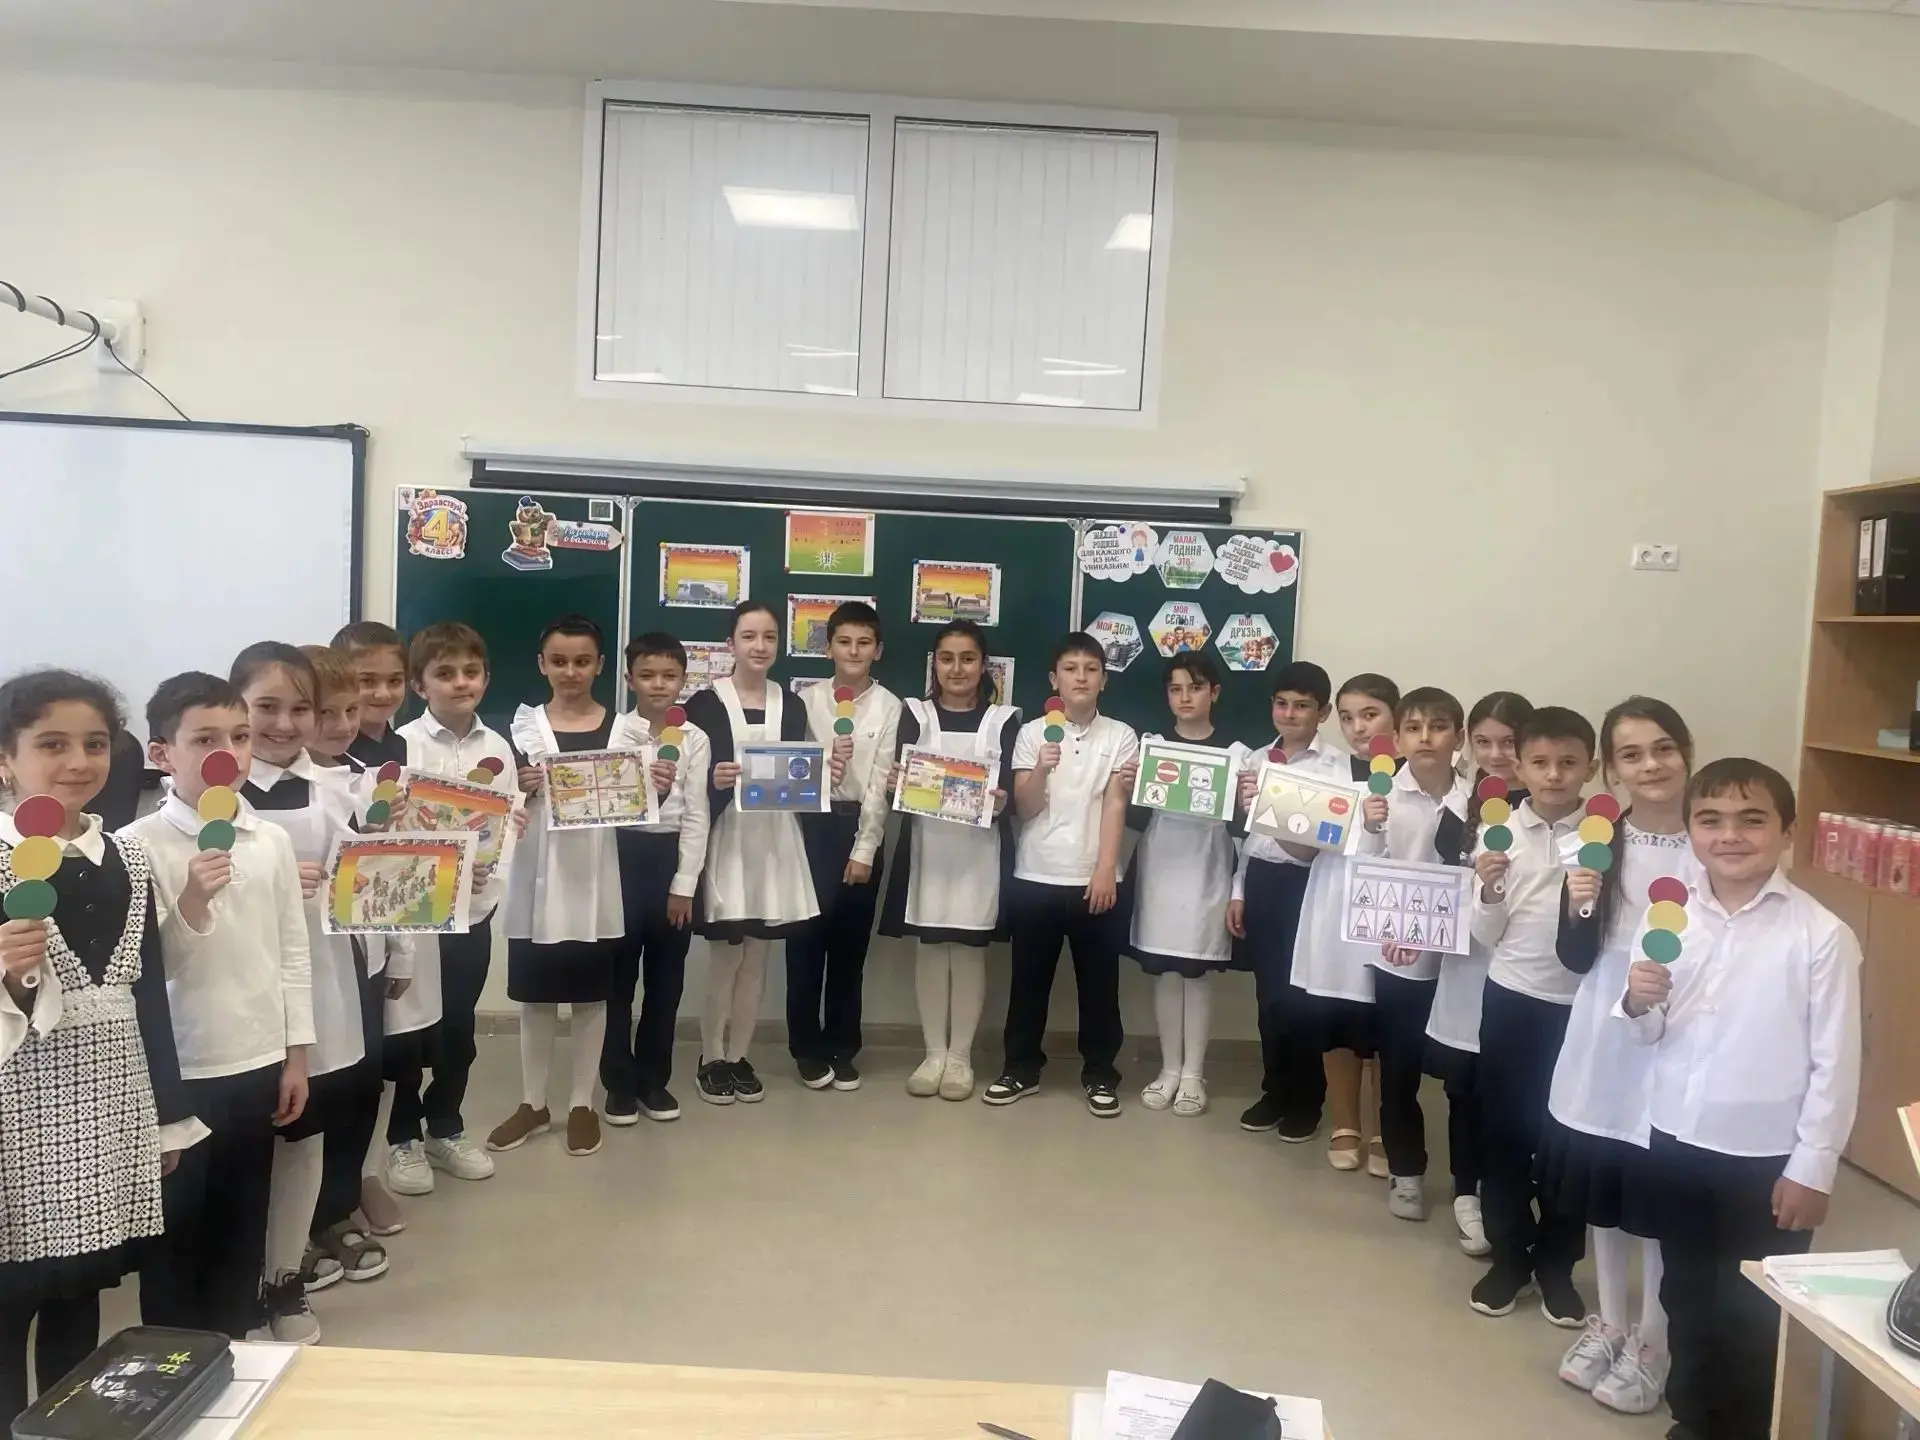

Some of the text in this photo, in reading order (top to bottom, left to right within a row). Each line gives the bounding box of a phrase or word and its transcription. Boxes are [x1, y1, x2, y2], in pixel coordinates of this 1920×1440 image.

[422, 508, 449, 547] 4
[1173, 535, 1197, 544] МАЛАЯ
[1173, 605, 1188, 614] МОЯ
[1096, 620, 1113, 632] МОЙ
[1230, 627, 1262, 639] ДРУЗЬЯ
